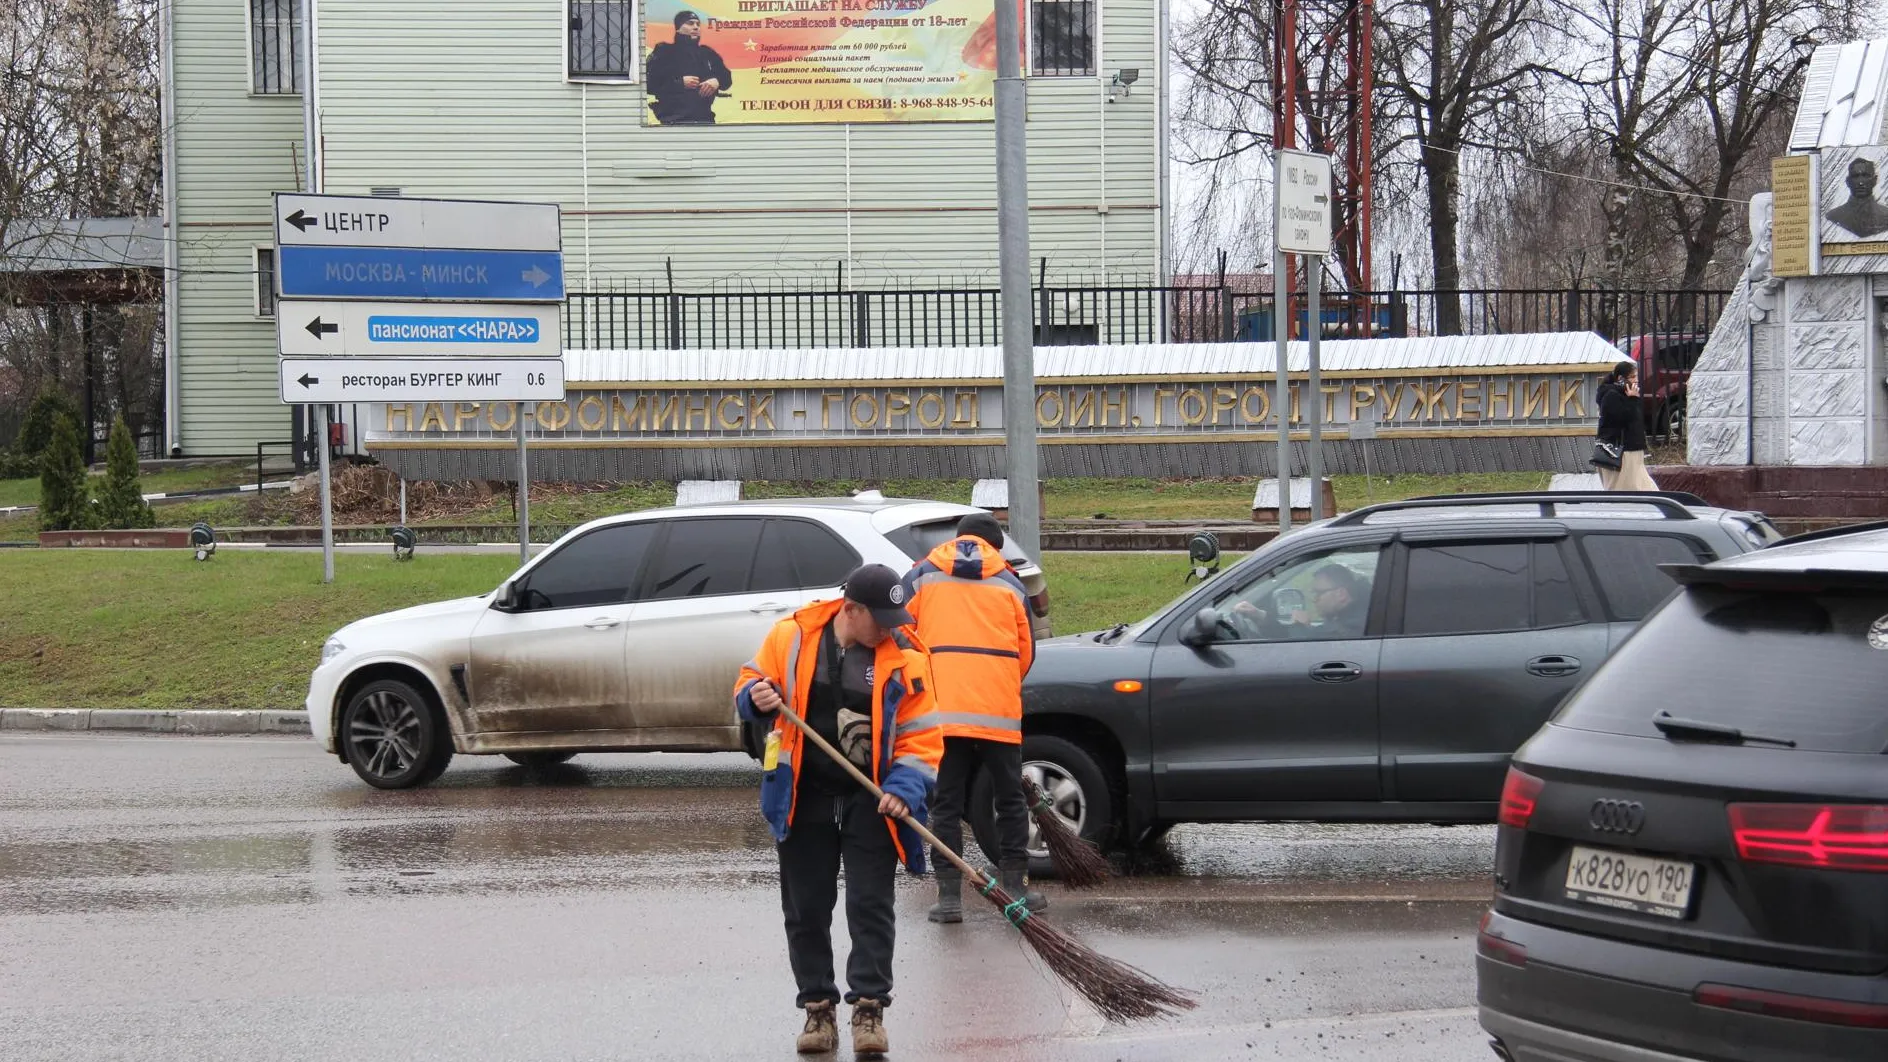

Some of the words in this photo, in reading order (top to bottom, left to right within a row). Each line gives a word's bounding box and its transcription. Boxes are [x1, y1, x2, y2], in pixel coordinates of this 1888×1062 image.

[738, 0, 837, 12] ПРИГЛАШАЕТ
[841, 0, 861, 11] НА
[865, 0, 927, 11] СЛУЖБУ
[707, 18, 762, 31] Граждан
[765, 17, 837, 28] Российской
[840, 16, 909, 30] Федерации
[912, 19, 926, 27] от
[760, 44, 808, 53] Заработная
[880, 42, 907, 51] рублей
[760, 54, 793, 62] Полный
[795, 54, 844, 62] социальный
[760, 66, 809, 74] Бесплатное
[811, 65, 865, 73] медицинское
[865, 65, 924, 73] обслуживание
[740, 99, 811, 111] ТЕЛЕФОН
[813, 99, 843, 111] ДЛЯ
[846, 97, 897, 110] СВЯЗИ:
[900, 97, 994, 109] 8-968-848-95-64
[324, 211, 390, 234] ЦЕНТР
[372, 323, 455, 340] пансионат
[341, 375, 406, 389] ресторан
[409, 372, 464, 388] БУРГЕР
[467, 372, 503, 388] КИНГ
[526, 372, 546, 387] 0.6
[822, 392, 981, 431] ГОРОД
[1035, 388, 1142, 429] ОИН,
[1319, 378, 1586, 424] ТРУЖЕНИК
[1654, 863, 1685, 892] 190
